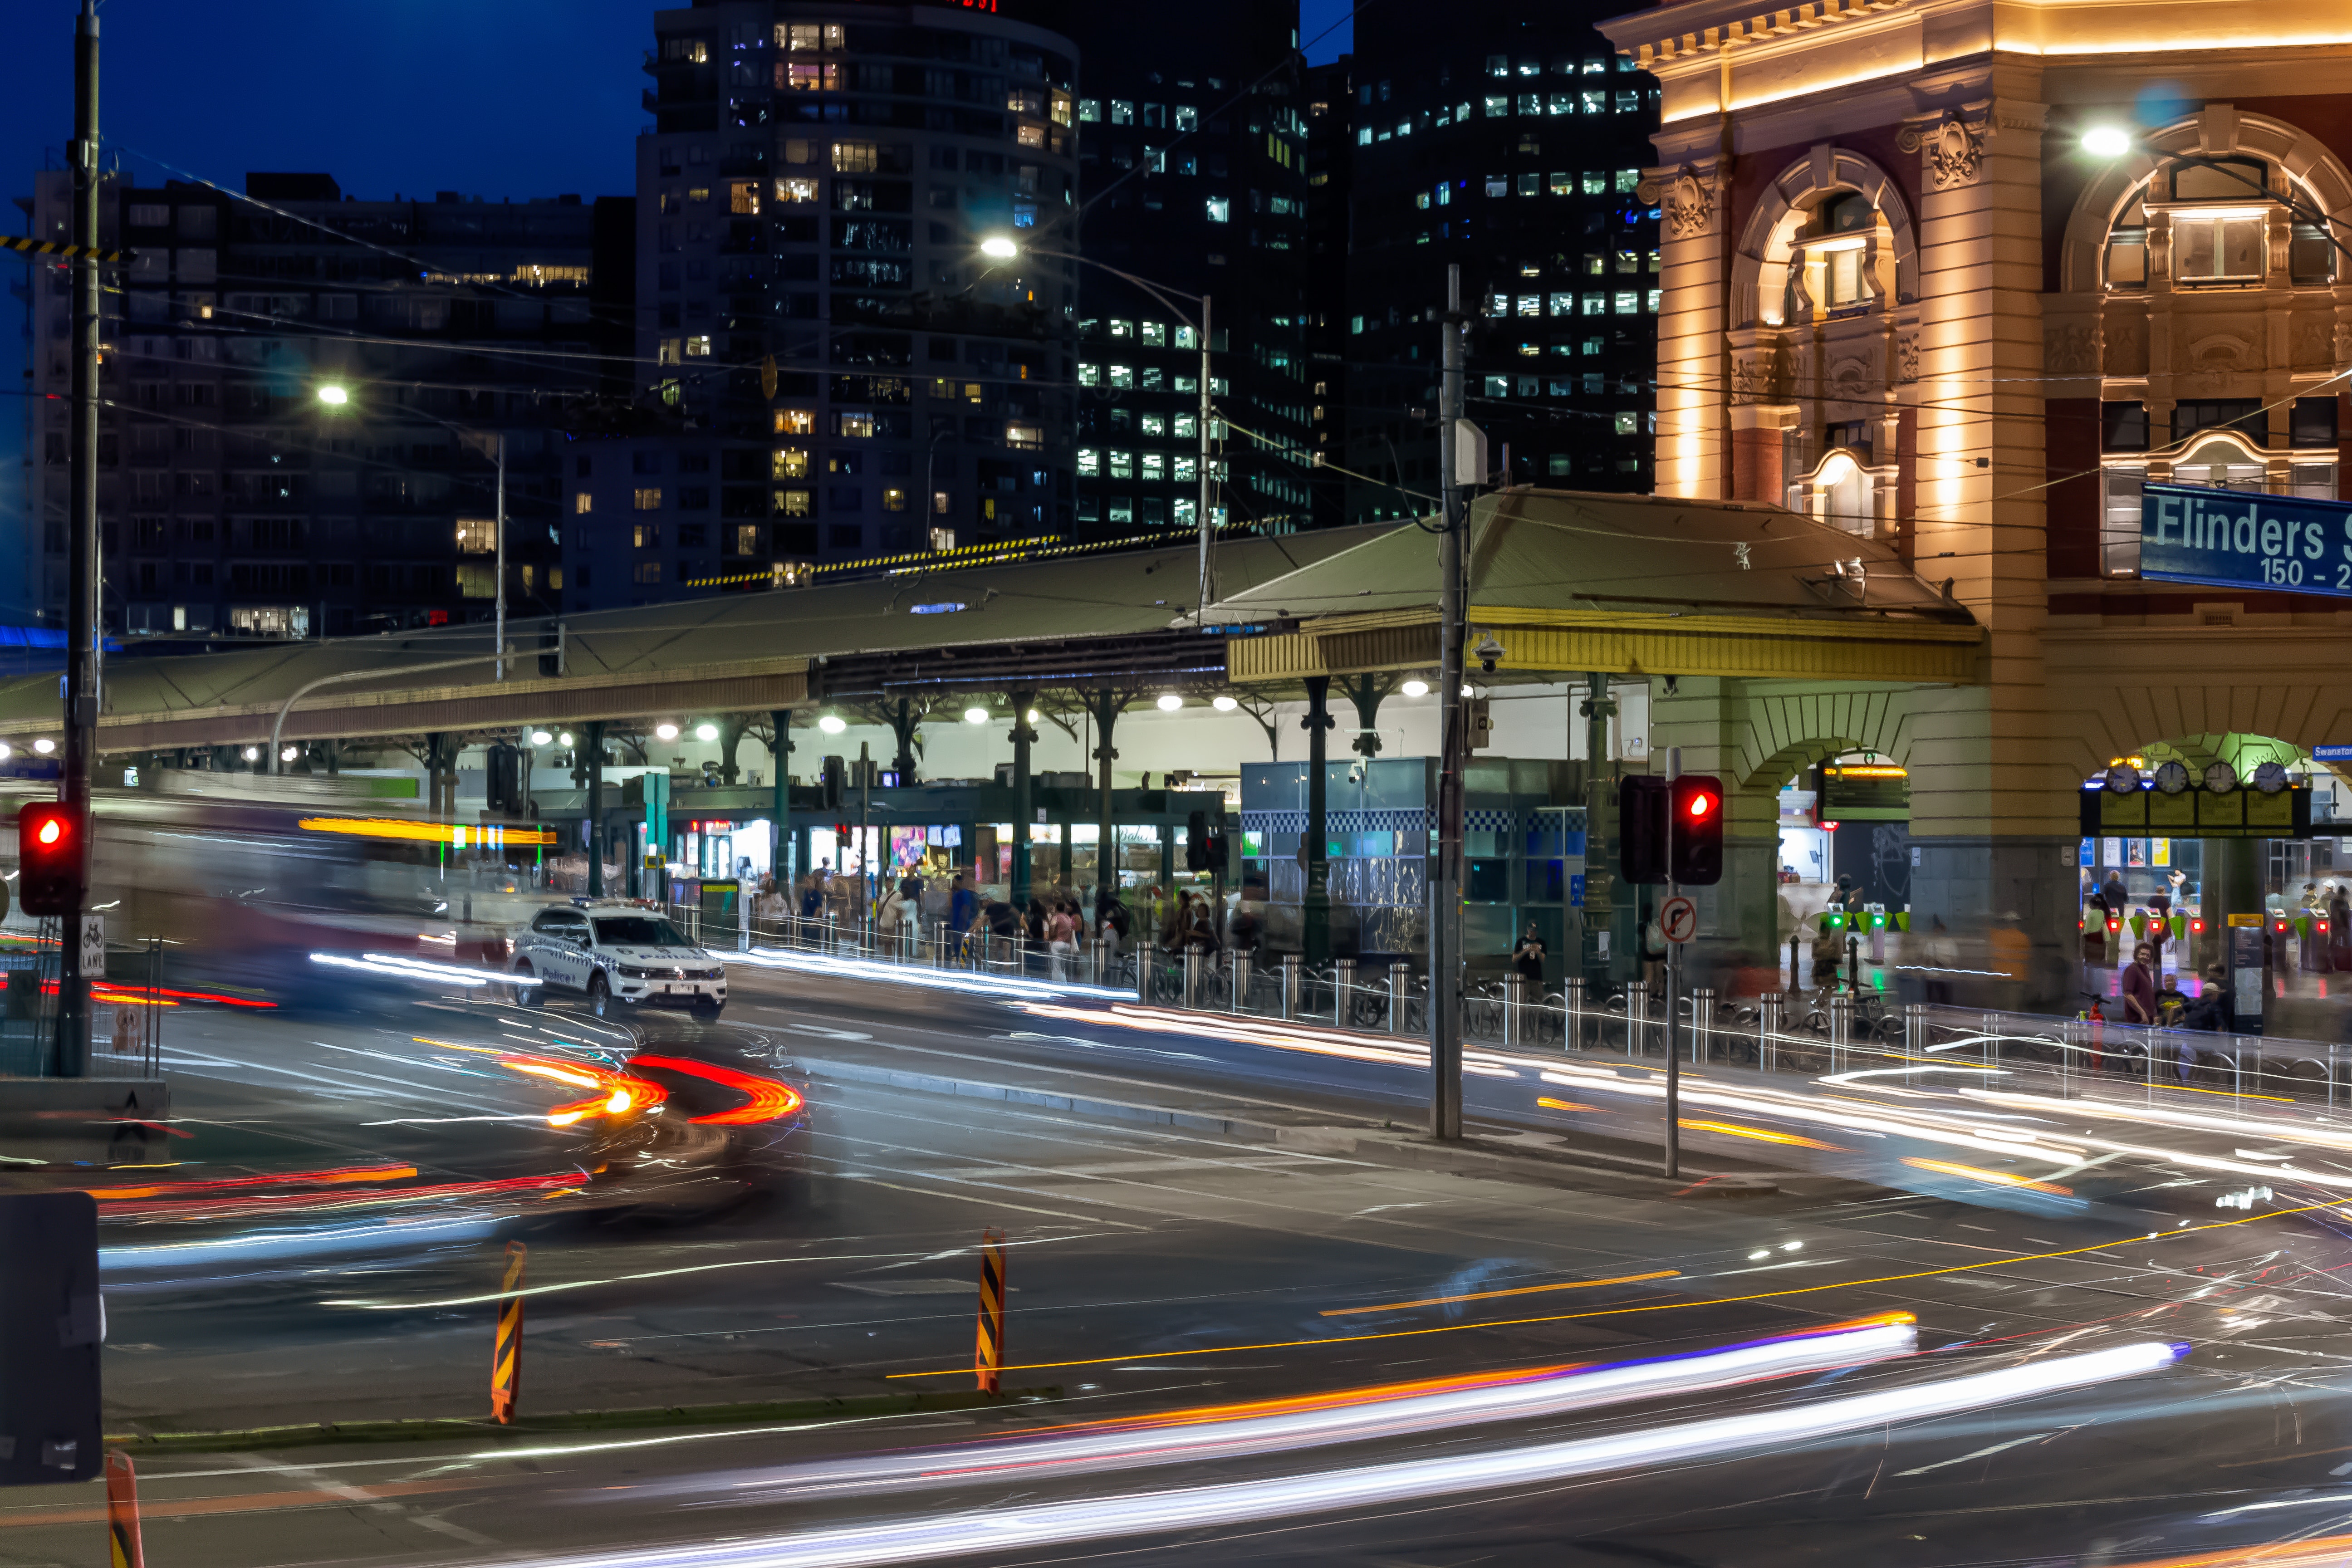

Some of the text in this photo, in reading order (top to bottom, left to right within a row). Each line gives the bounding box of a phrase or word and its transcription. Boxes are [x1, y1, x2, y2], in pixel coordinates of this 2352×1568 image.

[2157, 497, 2324, 559] Flinders
[2261, 558, 2303, 586] 150
[83, 953, 103, 969] LANE
